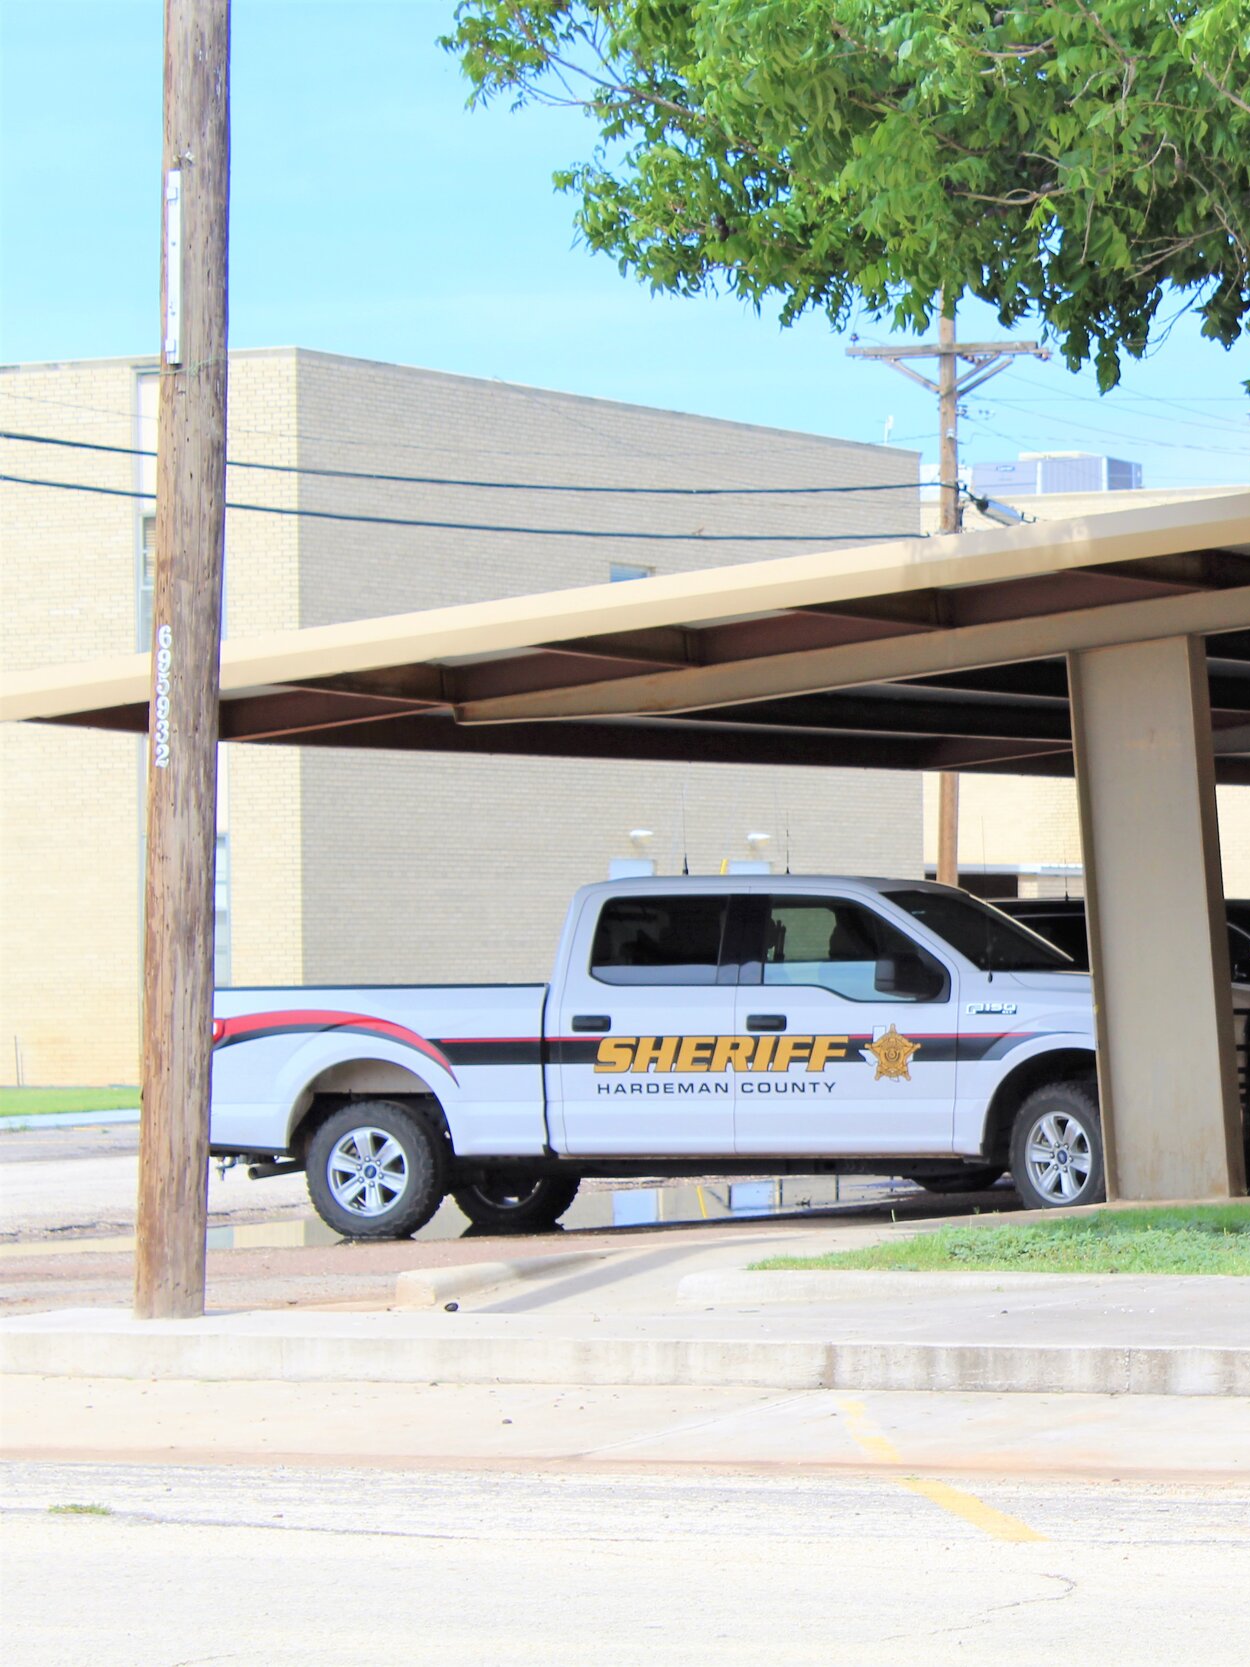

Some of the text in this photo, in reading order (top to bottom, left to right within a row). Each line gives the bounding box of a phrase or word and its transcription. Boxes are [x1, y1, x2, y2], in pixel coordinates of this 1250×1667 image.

[155, 624, 173, 769] 695932
[593, 1035, 849, 1073] SHERIFF
[597, 1081, 836, 1095] HARDEMAN COUNTY
